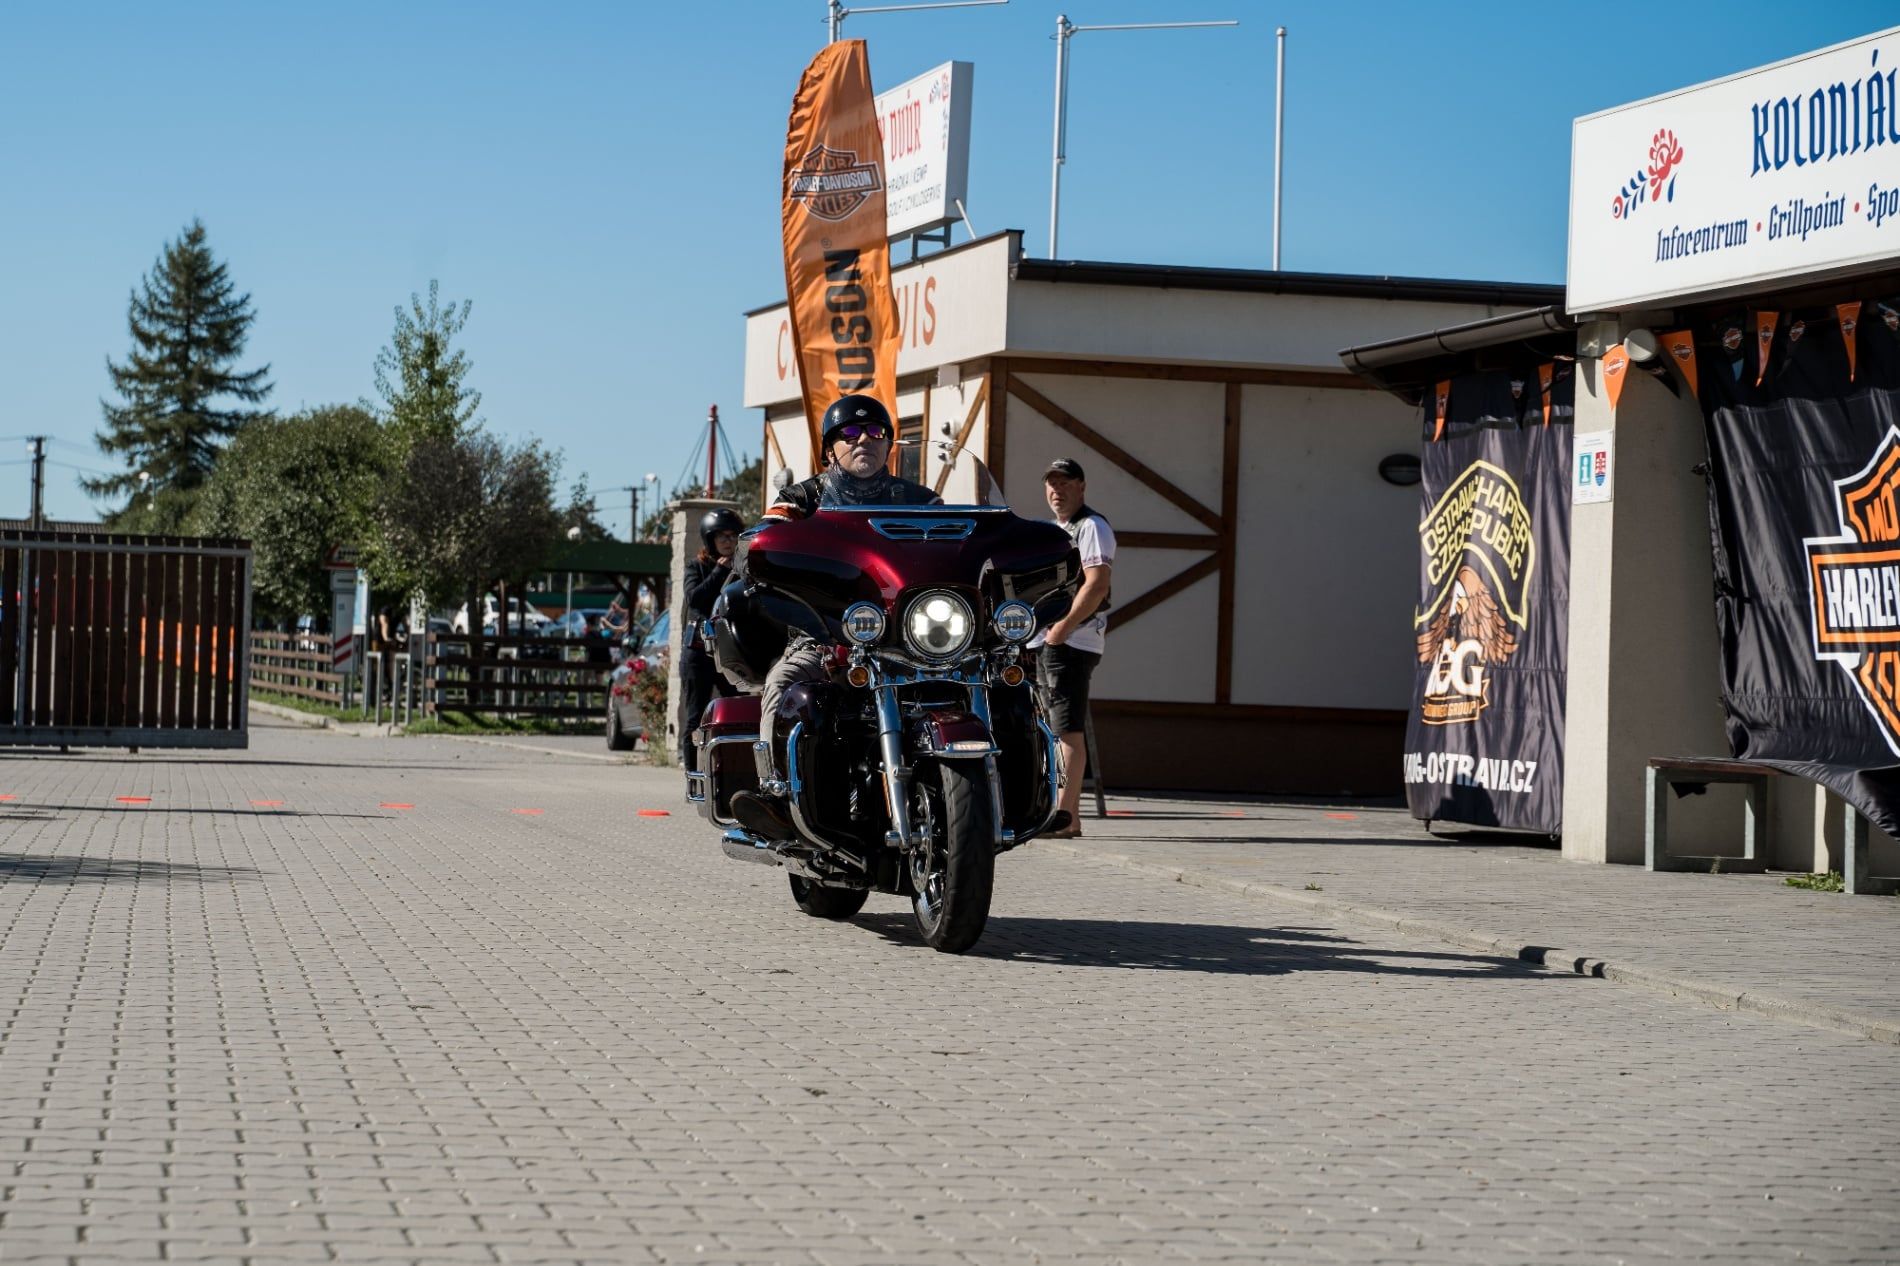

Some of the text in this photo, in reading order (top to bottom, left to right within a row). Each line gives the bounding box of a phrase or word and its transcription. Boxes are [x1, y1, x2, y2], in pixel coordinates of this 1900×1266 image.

[793, 171, 873, 193] HARLEY-DAVIDSON
[1655, 182, 1900, 263] Infocentrum Grillpoint Spo
[1822, 565, 1900, 628] HARLEY
